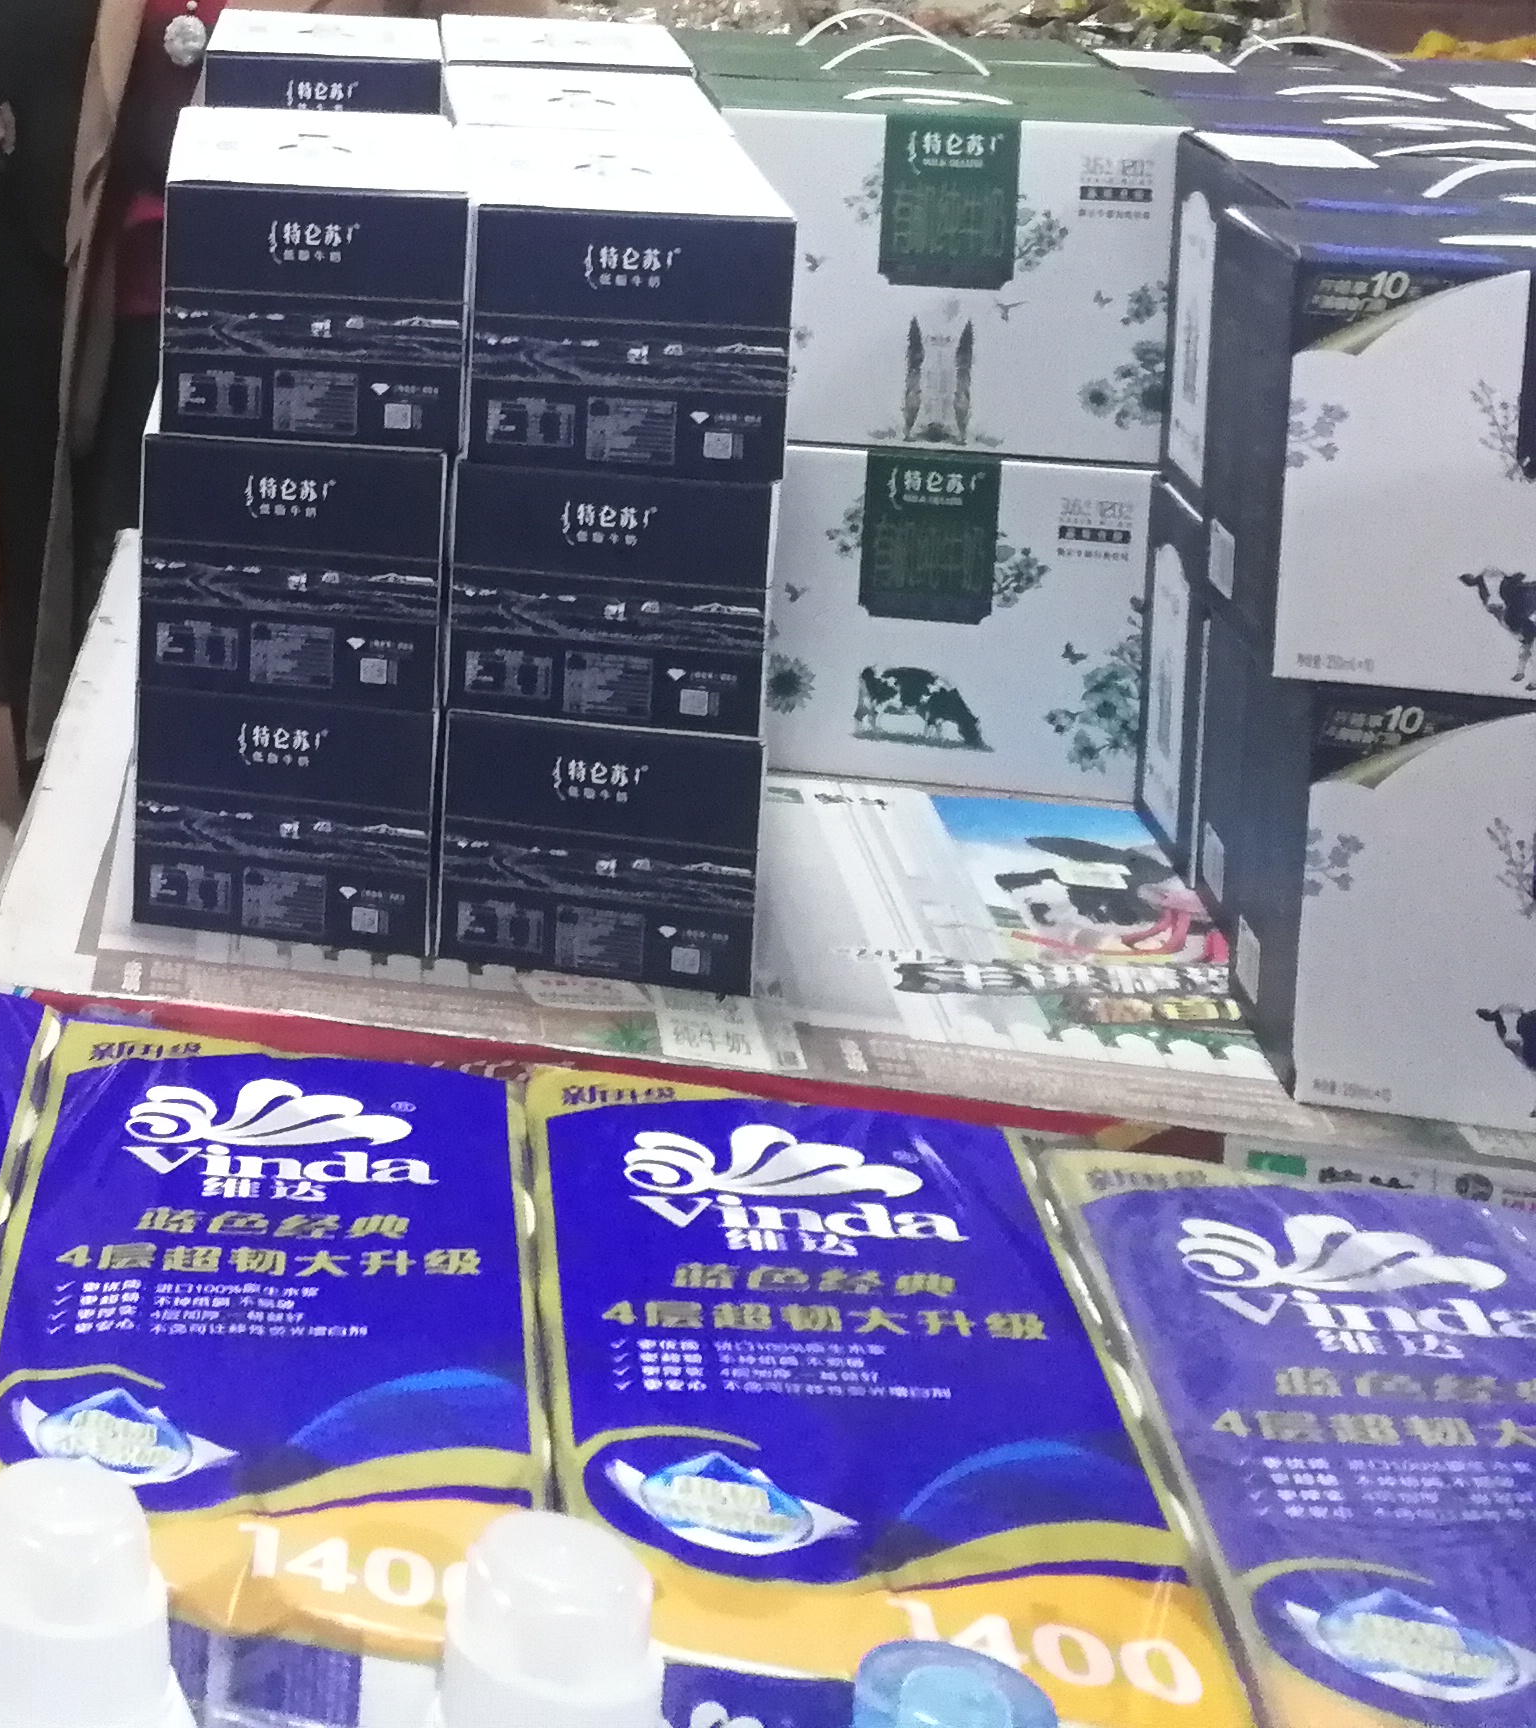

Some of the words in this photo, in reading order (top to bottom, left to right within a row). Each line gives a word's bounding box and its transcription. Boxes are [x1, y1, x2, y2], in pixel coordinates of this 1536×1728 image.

[922, 131, 986, 156] 特仑苏
[283, 222, 342, 246] 特仑苏
[599, 245, 661, 271] 特仑苏
[258, 478, 320, 503] 特仑苏
[903, 469, 965, 494] 特仑苏
[576, 504, 640, 530] 特仑苏
[253, 727, 312, 752] 特仑苏
[568, 761, 630, 787] 特仑苏
[89, 1041, 202, 1061] 新升级
[123, 1146, 438, 1185] Vinda
[201, 1177, 328, 1201] 维达
[135, 1206, 410, 1240] 蓝色经典
[630, 1194, 969, 1242] Vinda
[728, 1230, 858, 1257] 维达
[55, 1242, 483, 1277] 4层超韧大升级
[673, 1262, 956, 1297] 蓝色经典
[602, 1300, 1047, 1340] 4层超韧大升级
